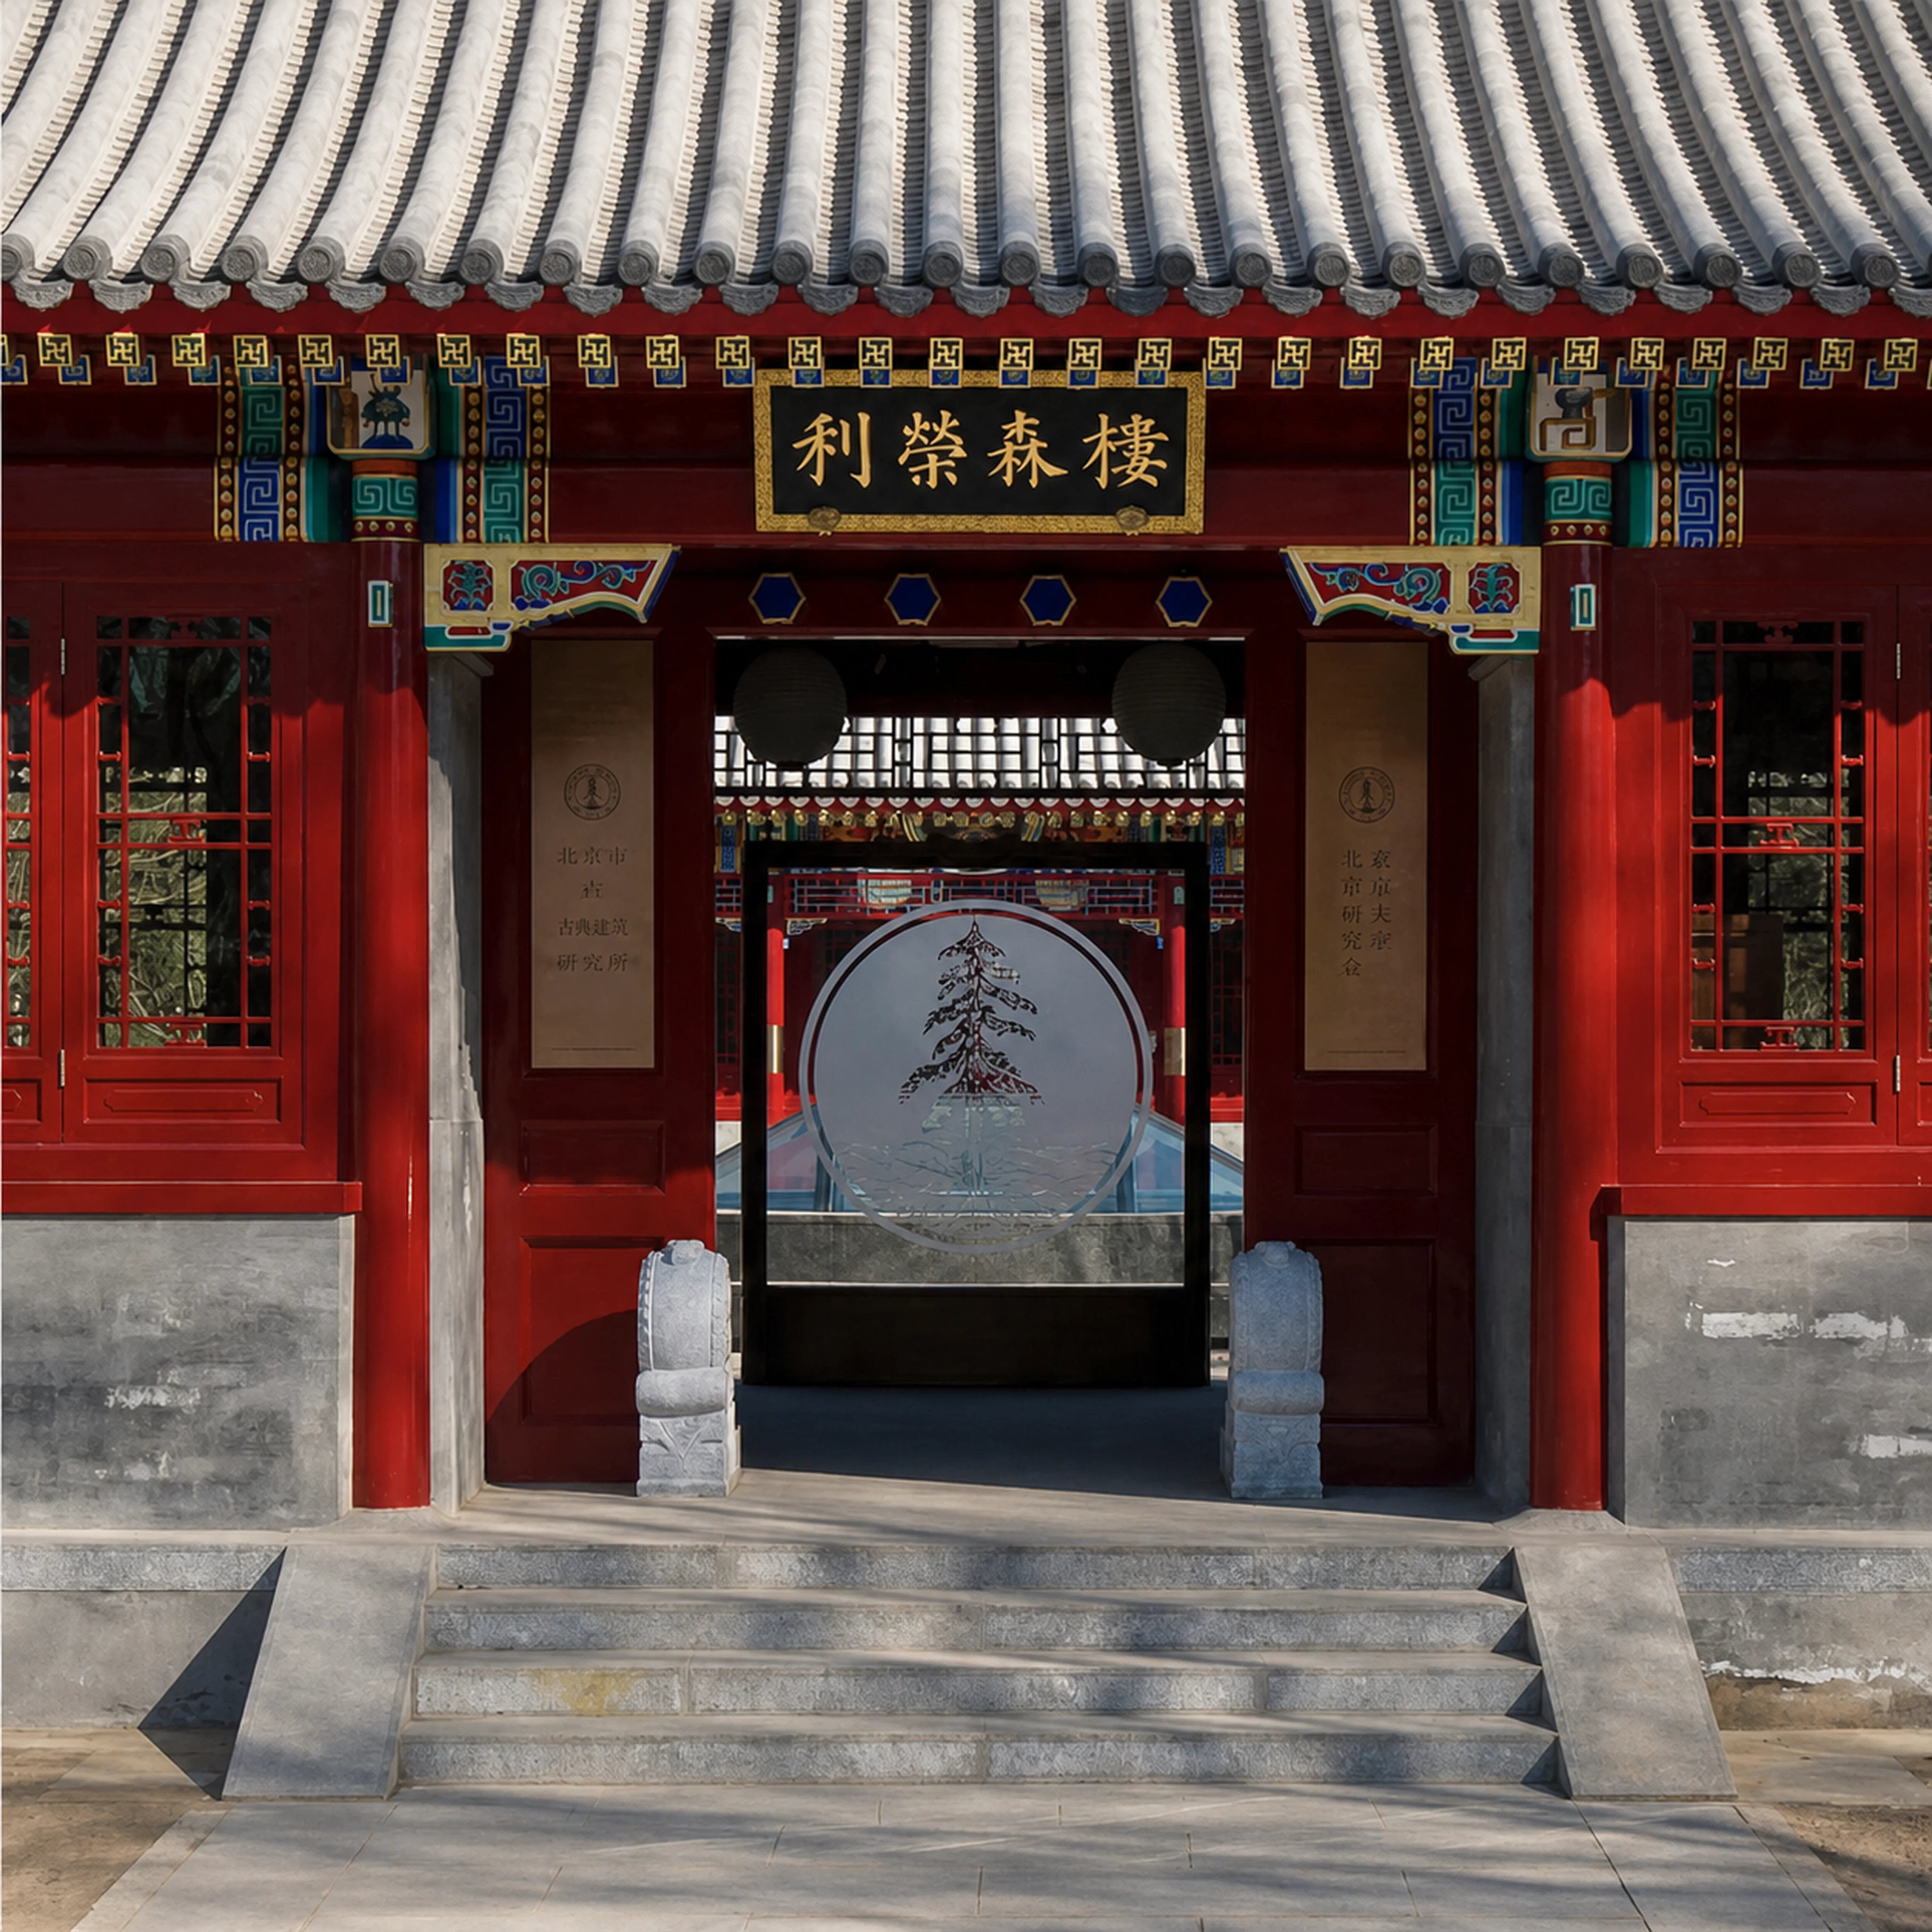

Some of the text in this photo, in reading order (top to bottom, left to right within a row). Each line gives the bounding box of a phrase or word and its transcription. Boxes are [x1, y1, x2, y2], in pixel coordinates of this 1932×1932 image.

[792, 410, 1169, 490] 利榮森樓
[558, 917, 628, 936] 古典建筑
[557, 953, 628, 972] 研究所
